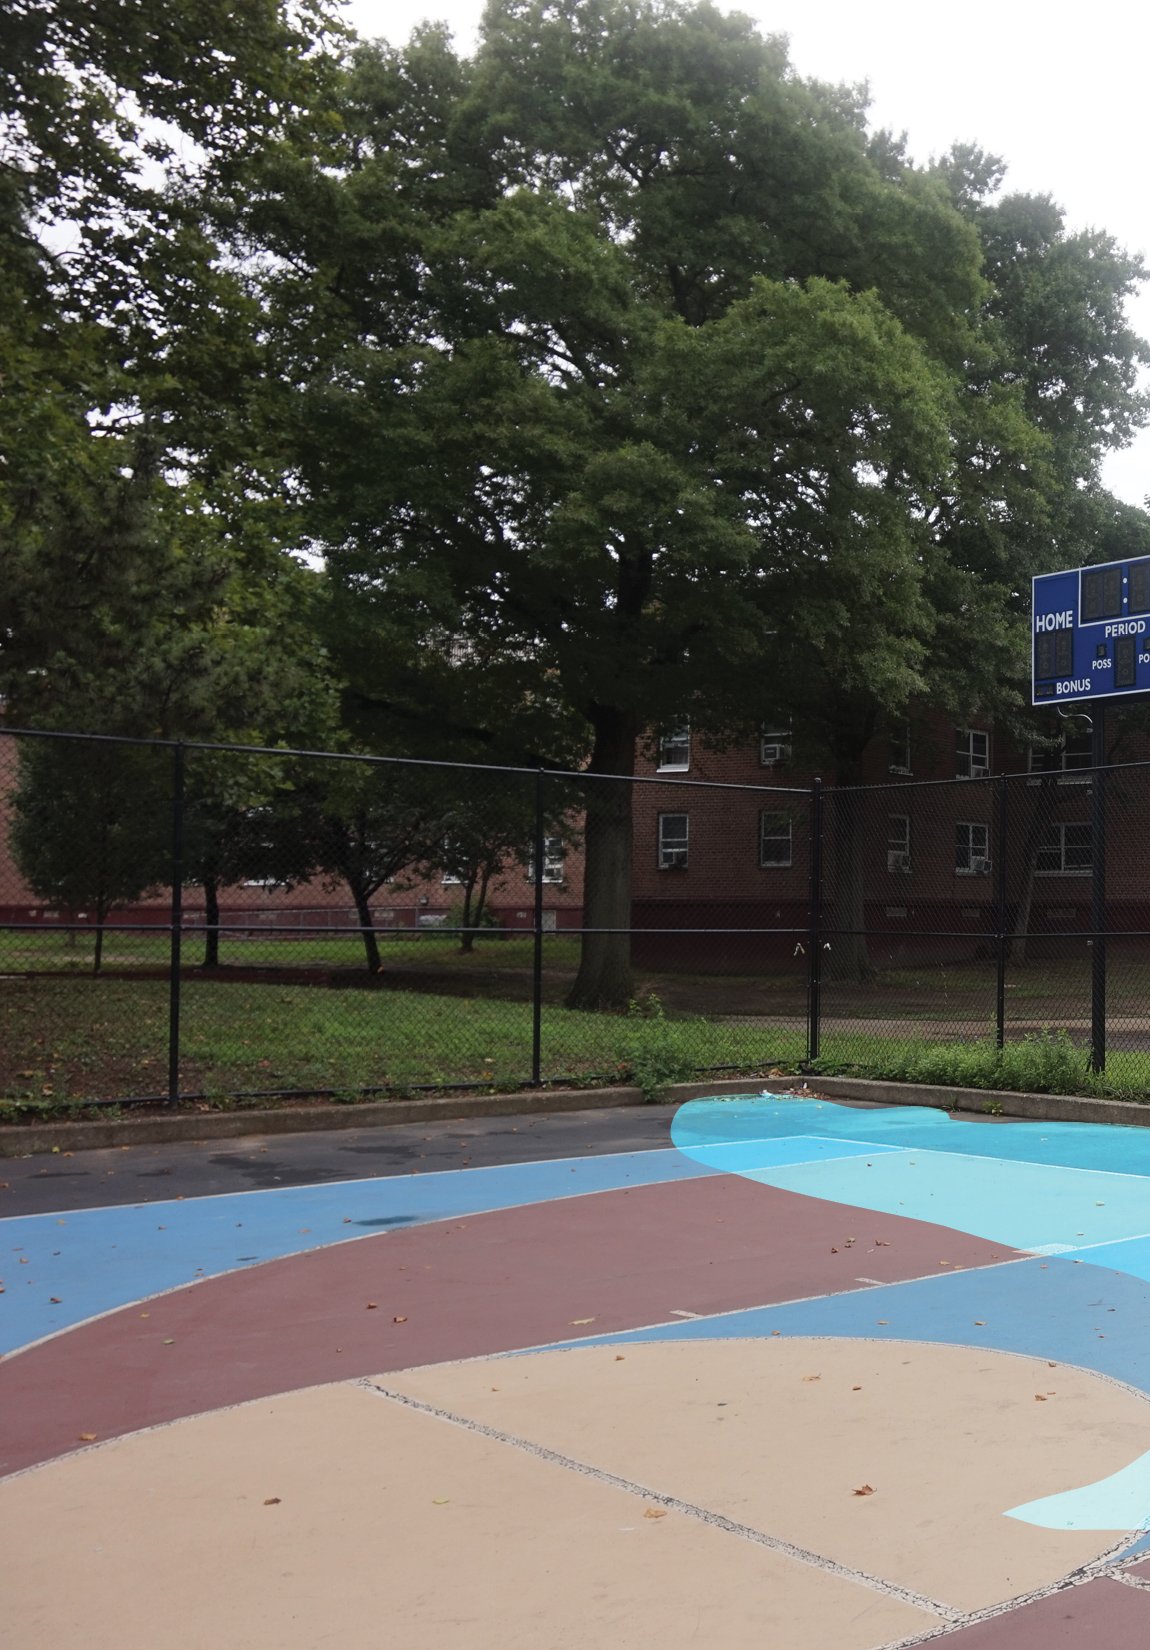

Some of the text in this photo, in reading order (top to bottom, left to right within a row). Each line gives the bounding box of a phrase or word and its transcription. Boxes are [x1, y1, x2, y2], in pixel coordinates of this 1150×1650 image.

[1036, 610, 1073, 632] HOME
[1105, 621, 1146, 637] PERIOD
[1092, 659, 1112, 670] POSS
[1056, 678, 1091, 694] BONUS
